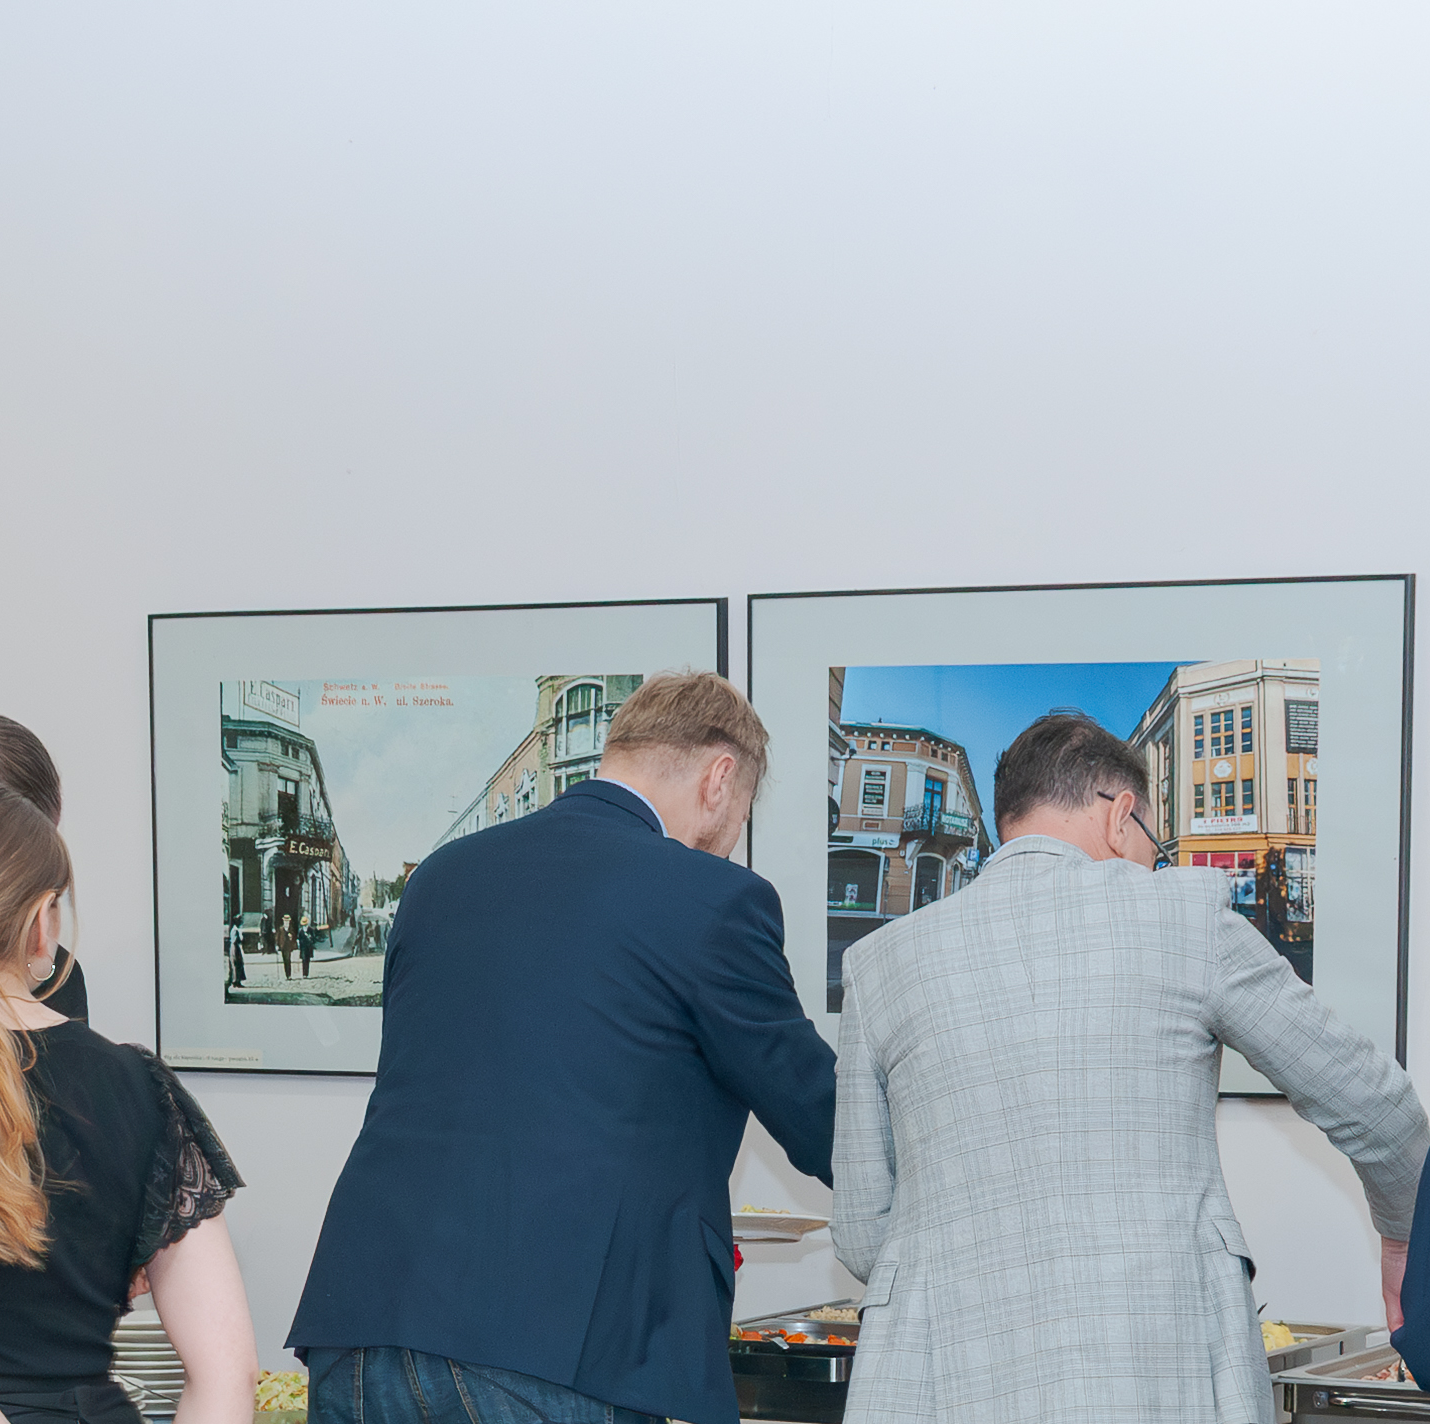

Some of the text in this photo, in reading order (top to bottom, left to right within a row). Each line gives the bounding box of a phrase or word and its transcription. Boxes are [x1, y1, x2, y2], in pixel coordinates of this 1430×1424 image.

[321, 693, 357, 707] Świecie
[360, 697, 370, 706] n.
[412, 695, 454, 707] Szeroka.
[872, 837, 888, 846] plus
